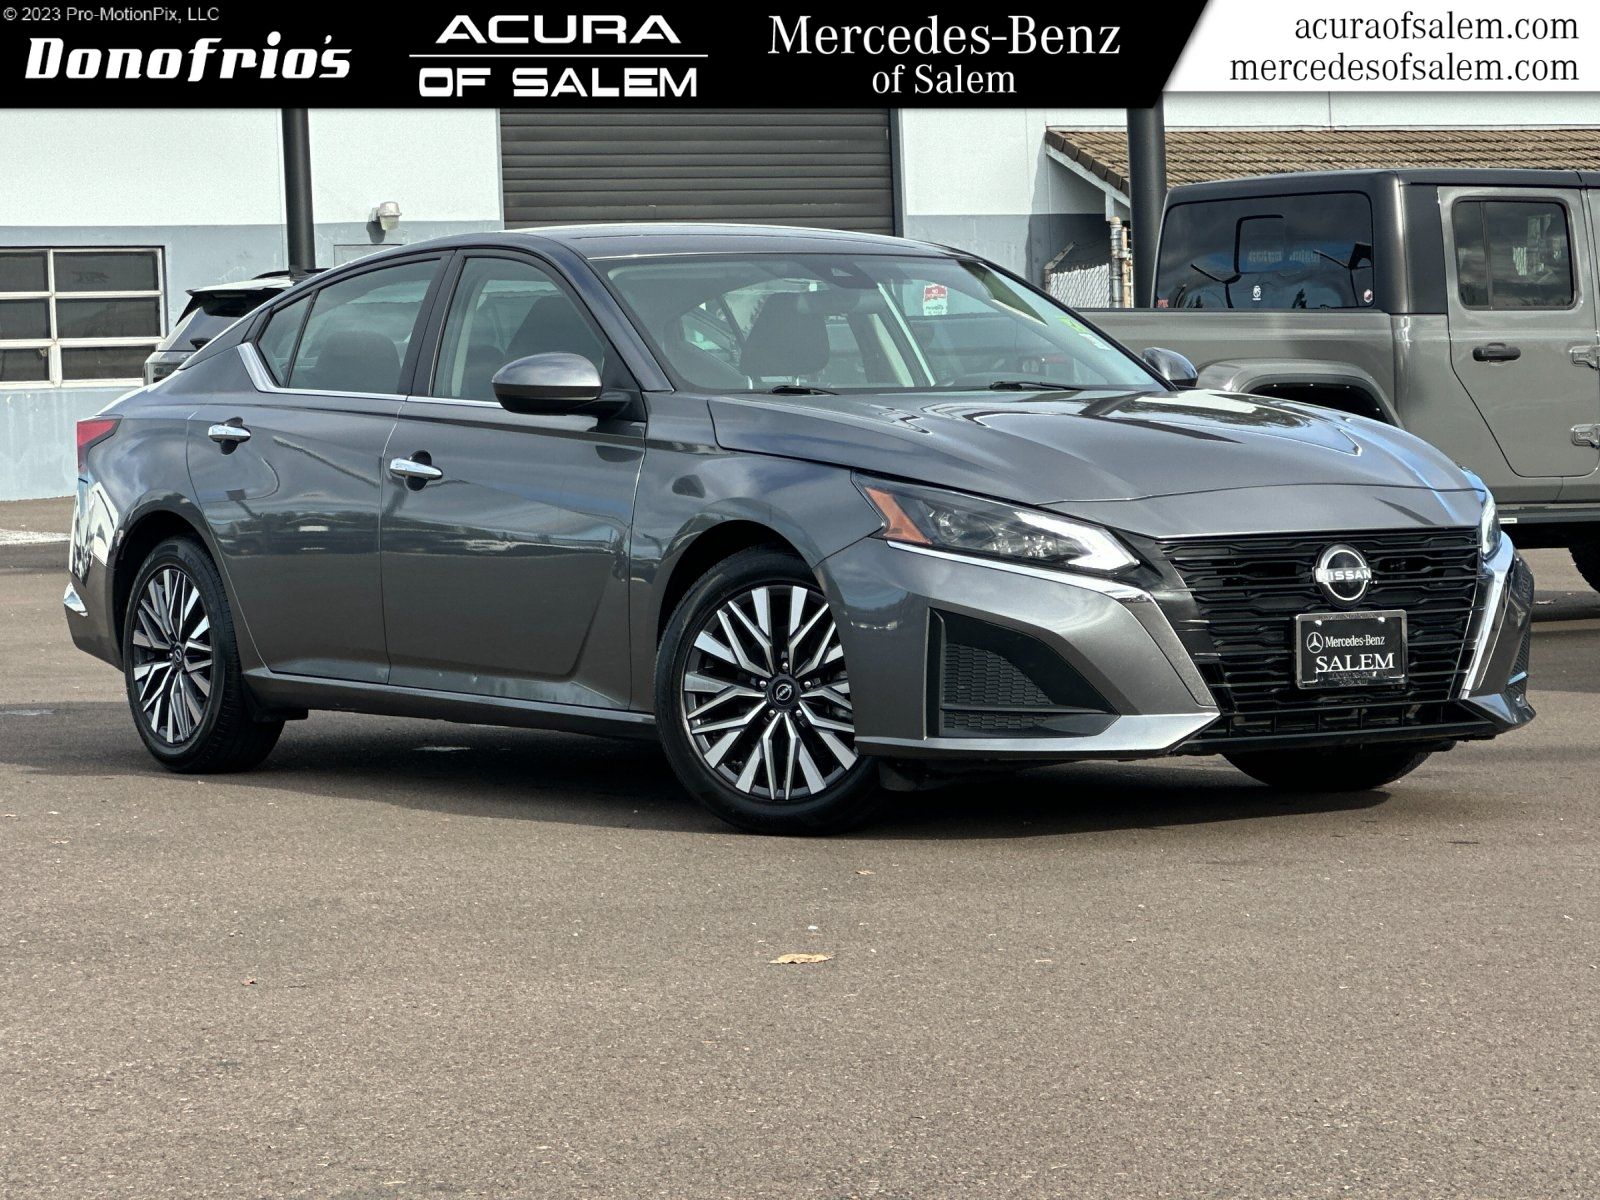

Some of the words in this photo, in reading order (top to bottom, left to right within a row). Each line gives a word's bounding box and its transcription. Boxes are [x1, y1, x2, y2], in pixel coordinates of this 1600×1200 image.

[1318, 569, 1372, 581] NISSAN
[1325, 635, 1385, 648] Mercedes-Benz
[1315, 652, 1395, 672] SALEM
